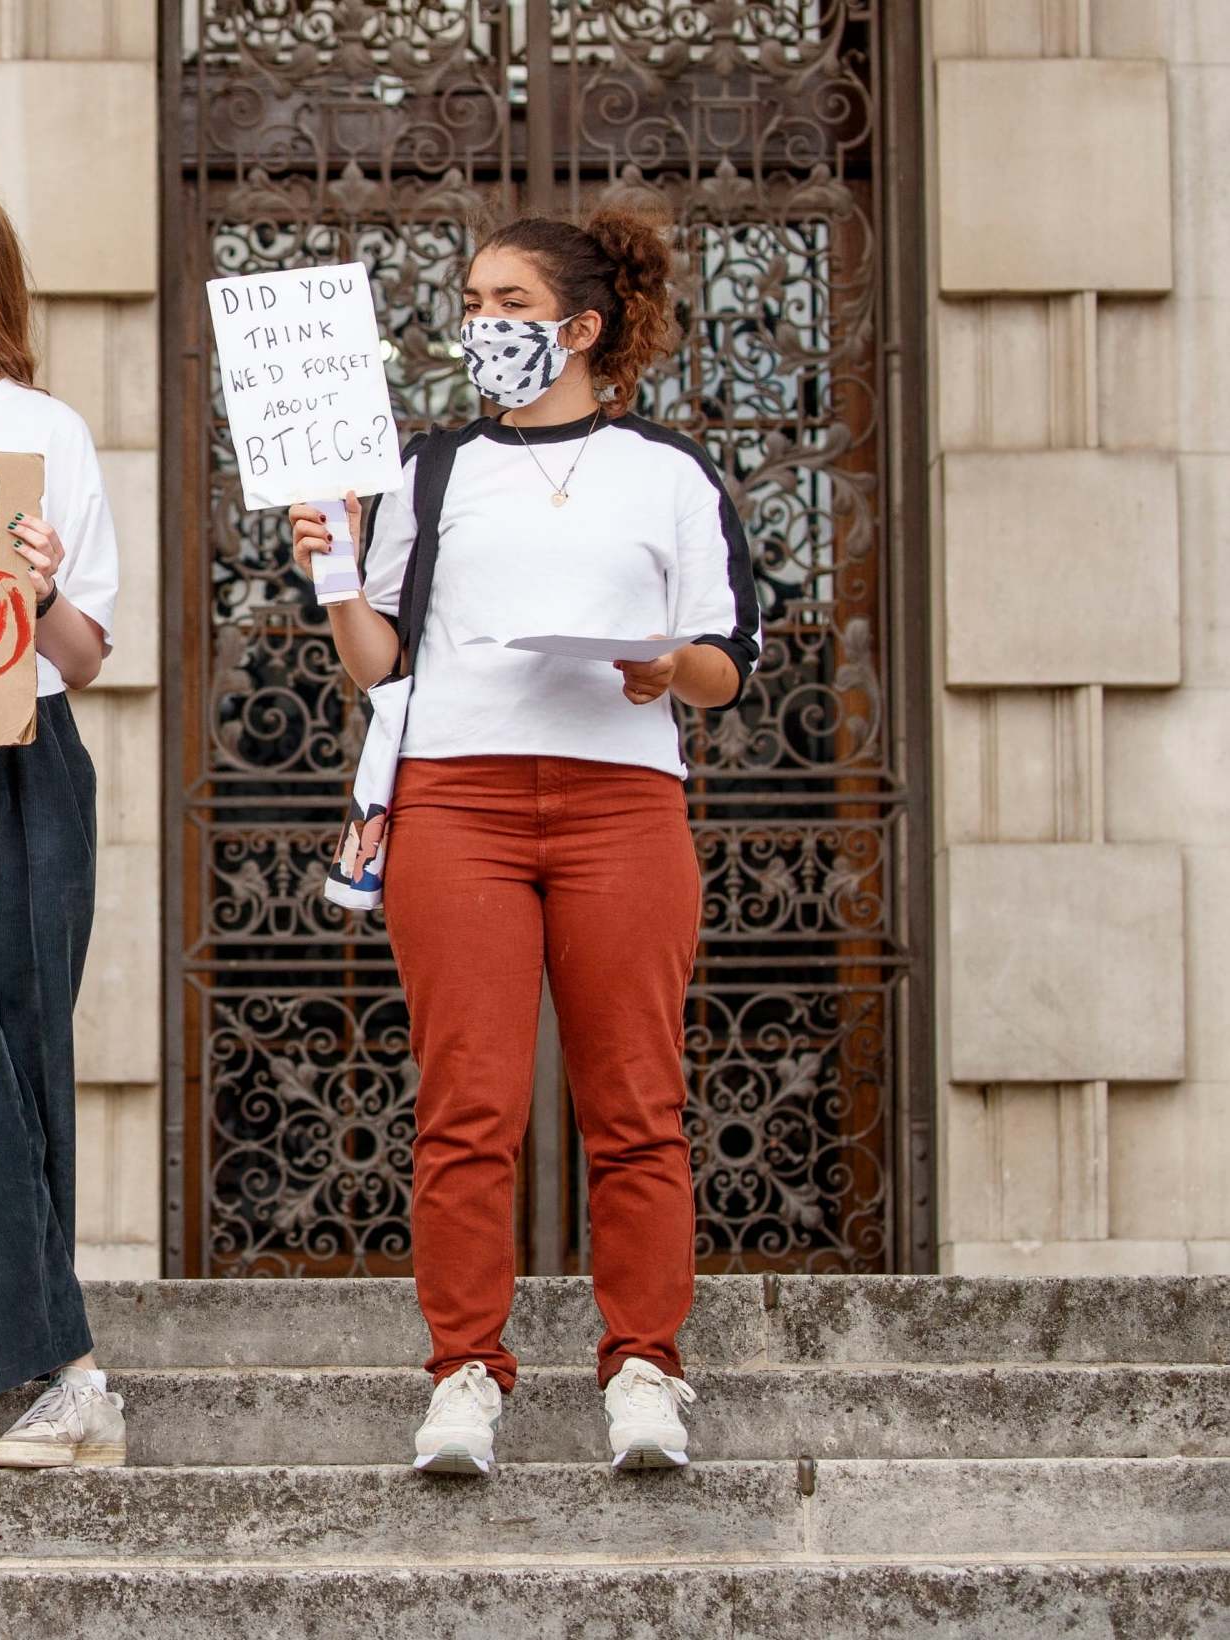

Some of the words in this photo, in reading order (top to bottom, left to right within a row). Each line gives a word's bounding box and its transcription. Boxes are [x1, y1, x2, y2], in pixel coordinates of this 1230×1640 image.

[221, 285, 277, 314] DID
[299, 279, 353, 304] YOU
[244, 321, 334, 349] THINK
[231, 364, 284, 393] WE'D
[302, 354, 370, 381] FORGET
[263, 393, 338, 421] ABOUT
[246, 415, 388, 476] BTECs?
